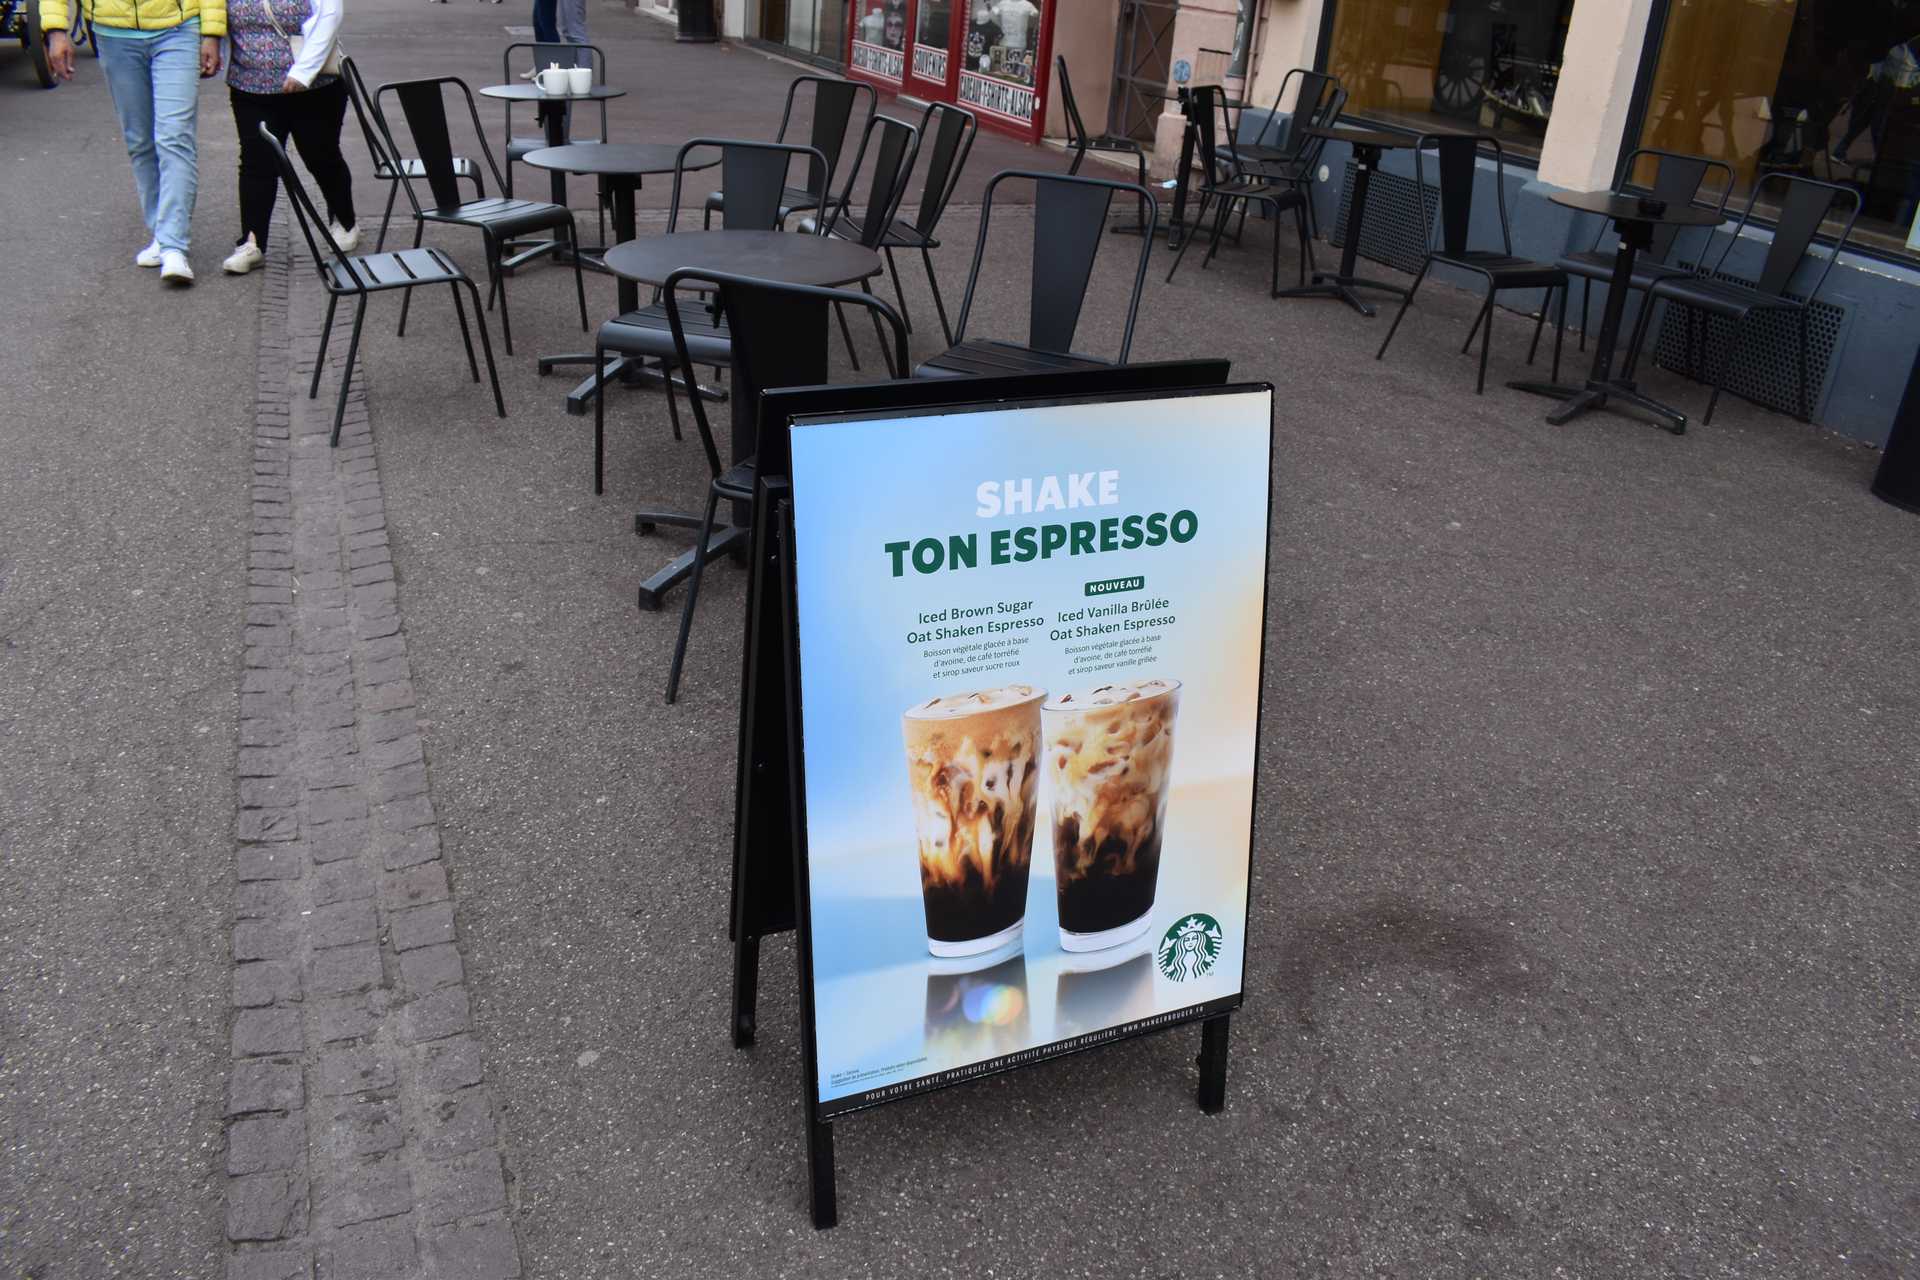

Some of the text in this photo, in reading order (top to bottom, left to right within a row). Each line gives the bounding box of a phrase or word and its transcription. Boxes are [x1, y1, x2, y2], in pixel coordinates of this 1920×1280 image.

[976, 470, 1119, 518] SHAKE
[885, 509, 1198, 577] TON ESPRESSO
[1089, 579, 1140, 593] NOUVEAU
[919, 600, 1033, 624] Iced Brown Sugar
[1058, 598, 1169, 623] Iced Vanilla Brûlée
[907, 617, 1044, 644] Oat Shaken Espresso
[1050, 615, 1175, 641] Oat Shaken Espresso
[923, 648, 951, 658] Boisson
[952, 643, 982, 654] végétale
[983, 640, 1006, 650] glacée
[1012, 636, 1029, 645] base
[967, 654, 977, 663] de
[977, 651, 993, 661] café
[1064, 645, 1090, 655] Boisson
[1091, 640, 1118, 651] végétale
[1104, 651, 1113, 659] de
[1114, 648, 1127, 658] café
[932, 660, 1020, 679] et sirop saveur sucre roux
[1068, 667, 1075, 675] et
[1076, 664, 1093, 675] sirop
[1094, 662, 1115, 671] saveur
[1116, 657, 1137, 668] vanille
[865, 1091, 886, 1101] POUR
[890, 1083, 912, 1095] VOTRE
[946, 1064, 986, 1080] PRATIQUEZ
[989, 1059, 1004, 1069] UNE
[1007, 1049, 1040, 1064] ACTIVITÉ
[1043, 1040, 1077, 1055] PHYSIQUE
